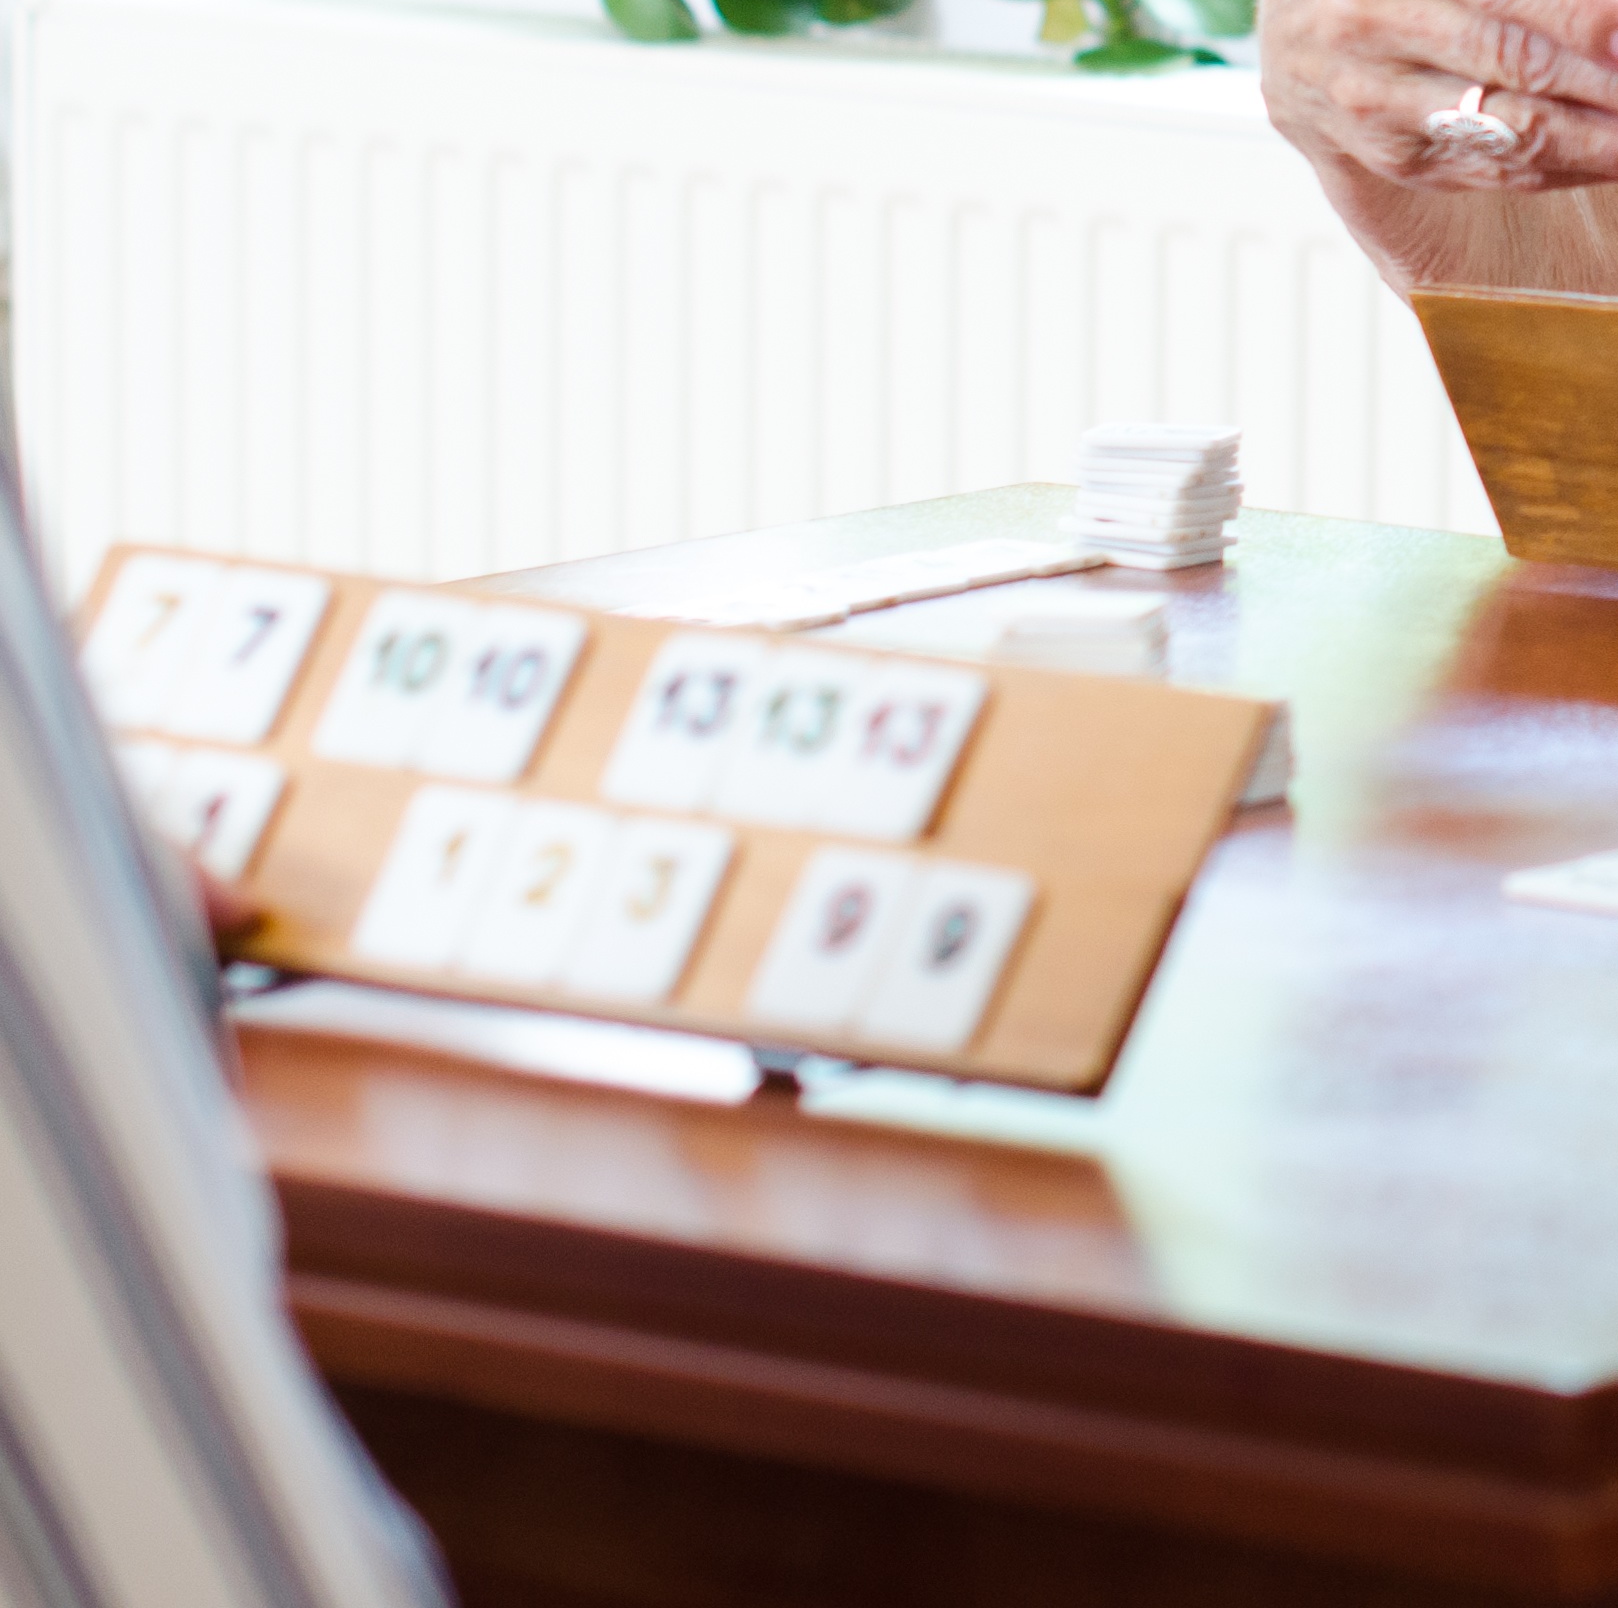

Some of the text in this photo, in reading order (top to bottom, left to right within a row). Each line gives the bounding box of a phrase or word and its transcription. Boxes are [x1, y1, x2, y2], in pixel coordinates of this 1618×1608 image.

[228, 602, 281, 668] 7
[371, 632, 546, 712] 10 10
[658, 672, 738, 737] 13
[863, 702, 946, 768] 13
[522, 842, 573, 906] 2
[625, 855, 678, 923] 3
